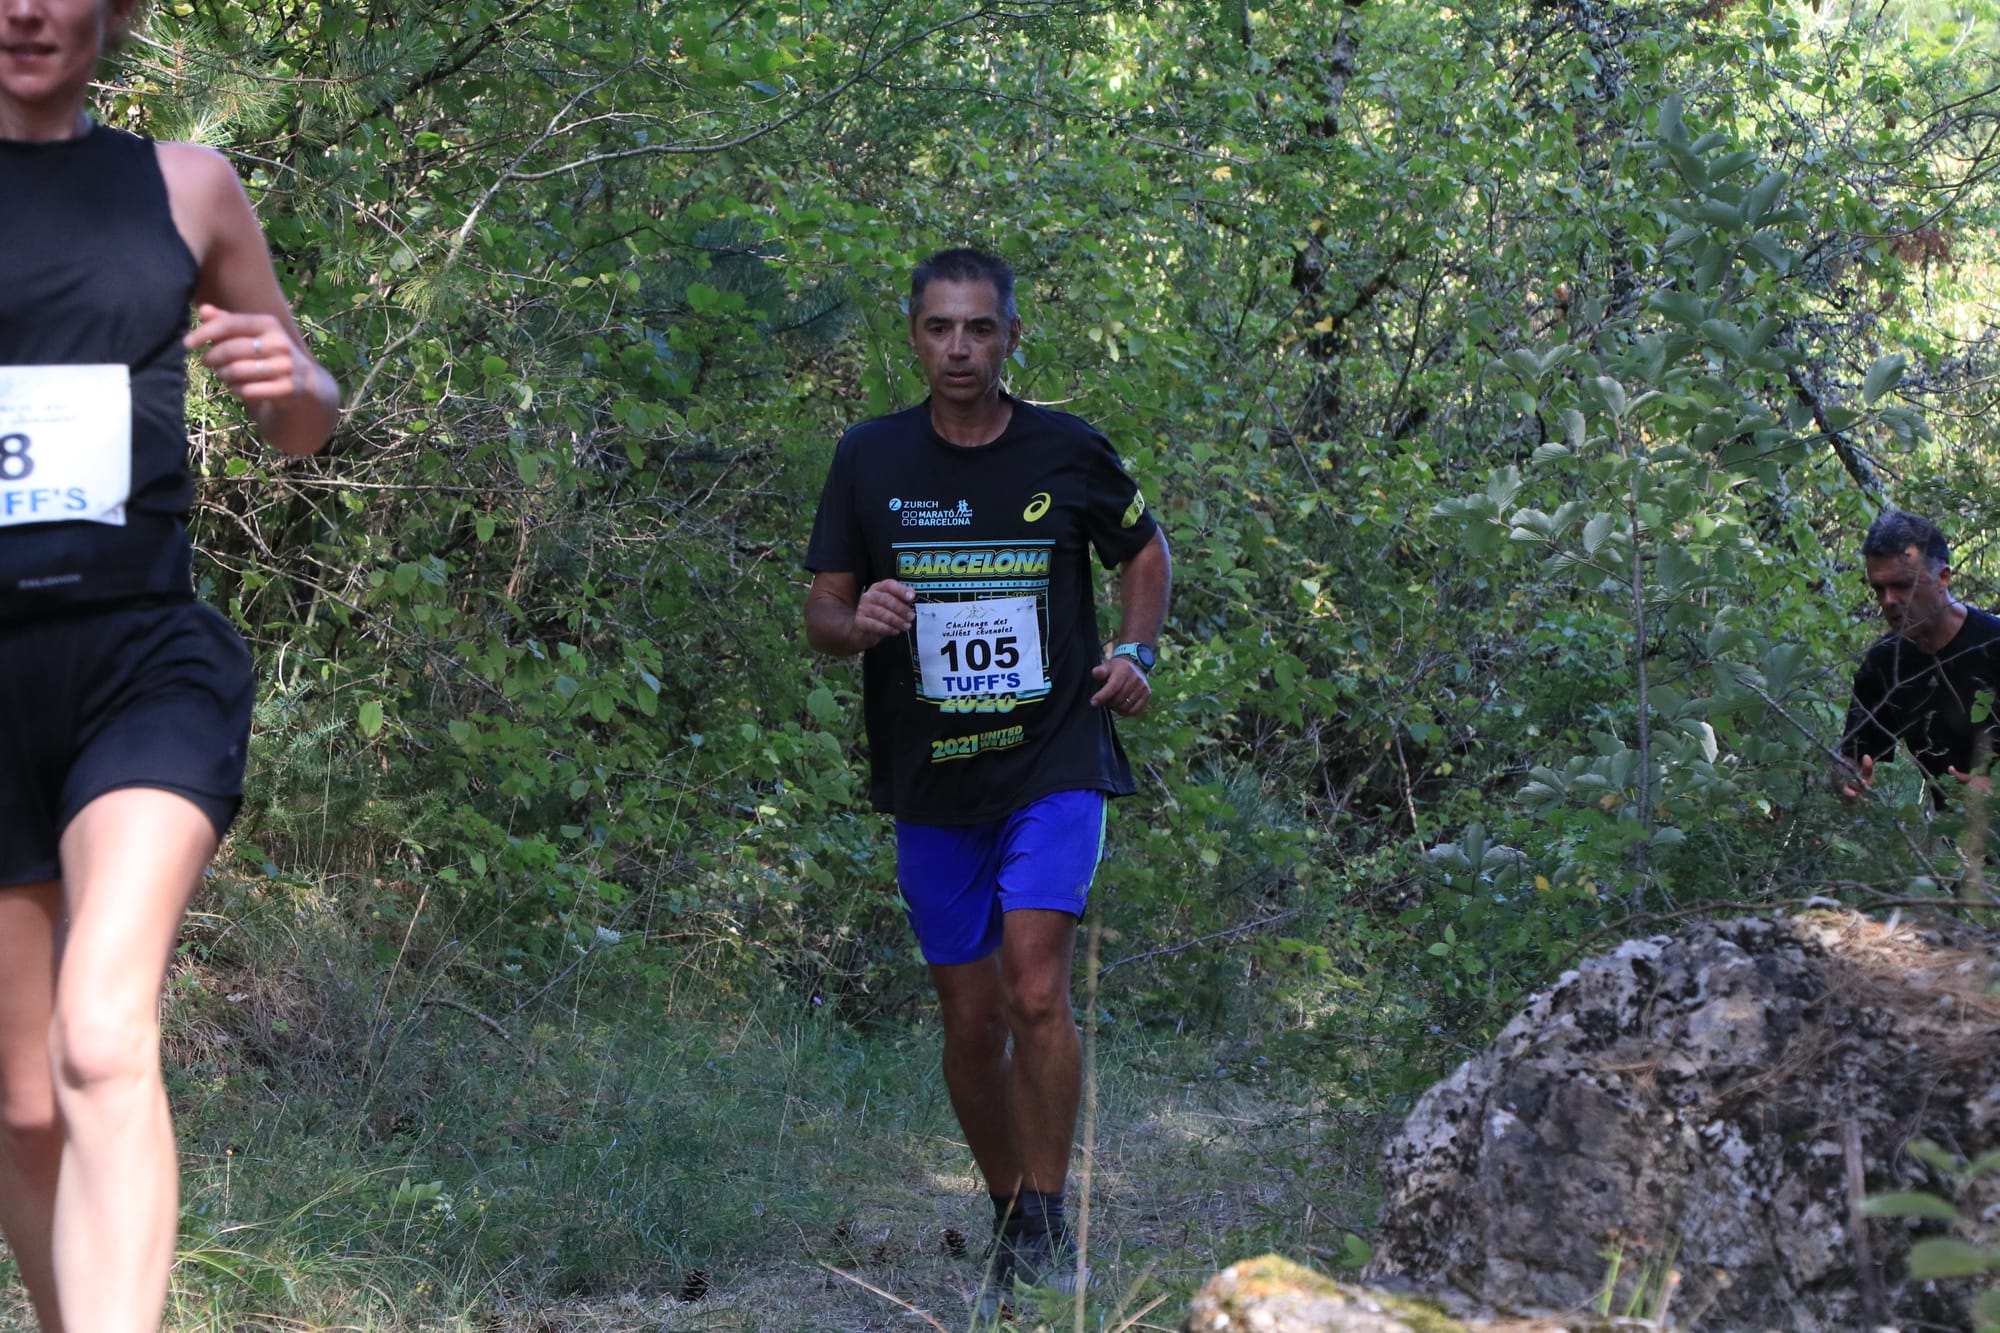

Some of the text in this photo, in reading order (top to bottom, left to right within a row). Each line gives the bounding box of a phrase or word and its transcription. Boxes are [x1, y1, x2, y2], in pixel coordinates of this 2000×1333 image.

[0, 487, 87, 515] FF'S
[903, 501, 939, 509] ZURICH
[918, 509, 955, 518] MARATÓ
[918, 518, 971, 526] BARCELONA
[898, 550, 1050, 576] BARCELONA
[945, 618, 1008, 630] Challenge des
[940, 636, 1019, 672] 105
[942, 673, 1021, 691] TUFF'S
[931, 725, 1023, 758] 2021 UNITED
